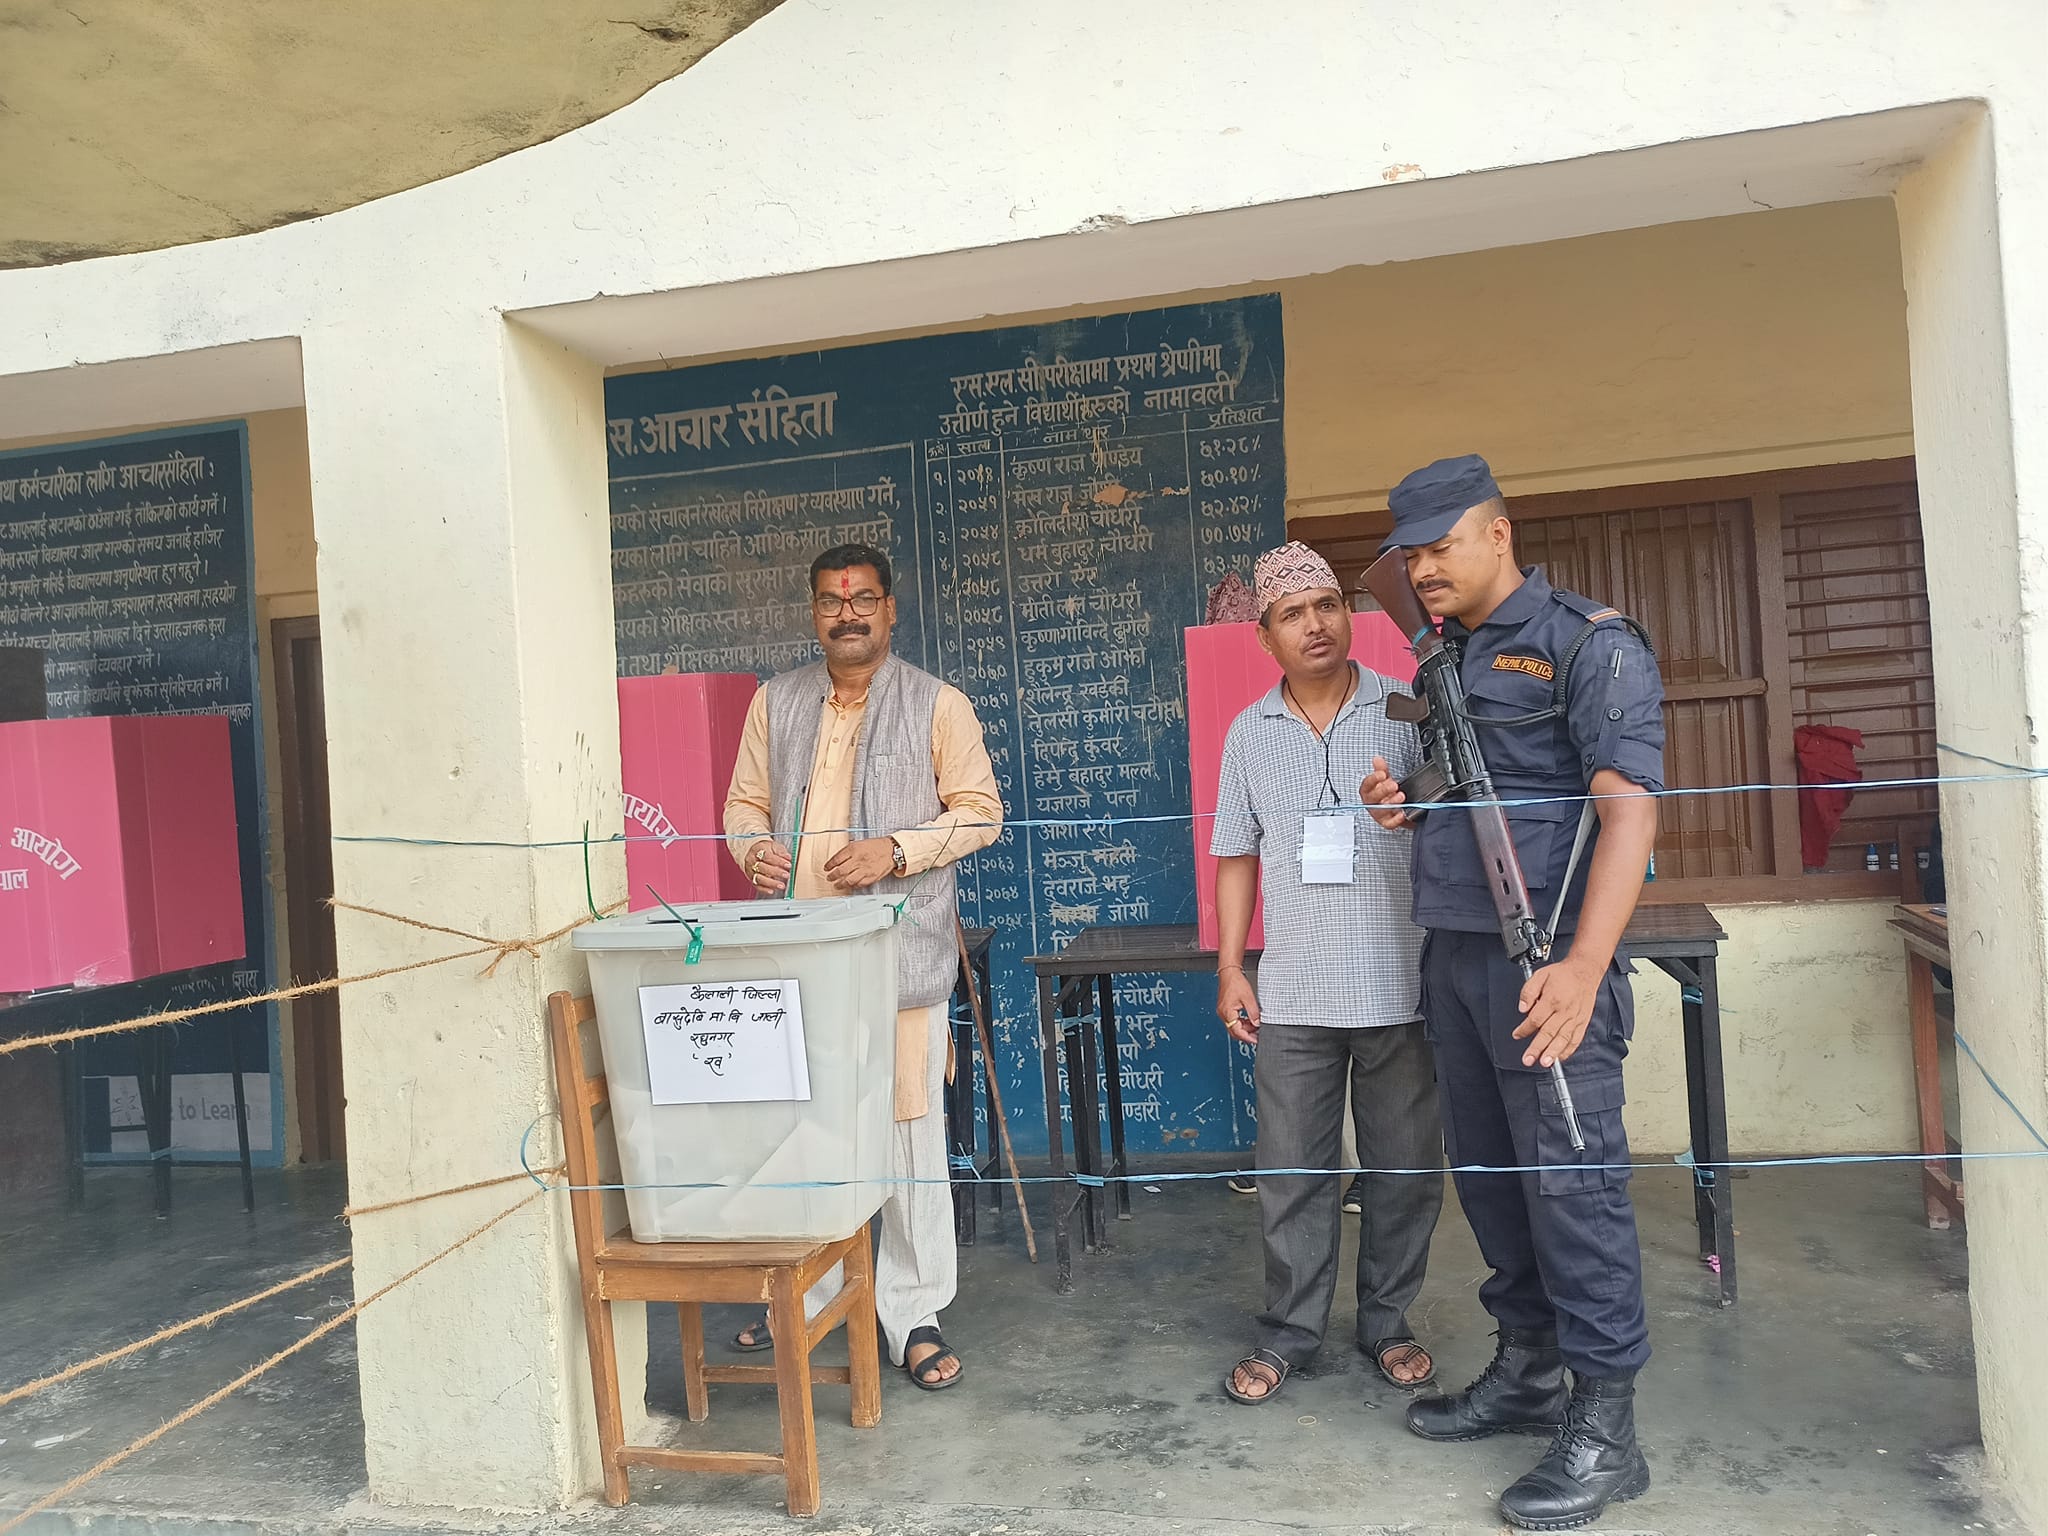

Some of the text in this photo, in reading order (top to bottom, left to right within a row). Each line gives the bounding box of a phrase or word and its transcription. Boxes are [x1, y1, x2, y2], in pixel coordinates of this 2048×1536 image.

[1114, 353, 1157, 383] प्रथम
[1143, 370, 1238, 411] नामावली
[736, 384, 839, 447] संहिता
[1207, 406, 1266, 429] प्रतिशत
[85, 460, 117, 498] लागि
[10, 826, 83, 881] आयोग
[1106, 896, 1150, 923] जोशी
